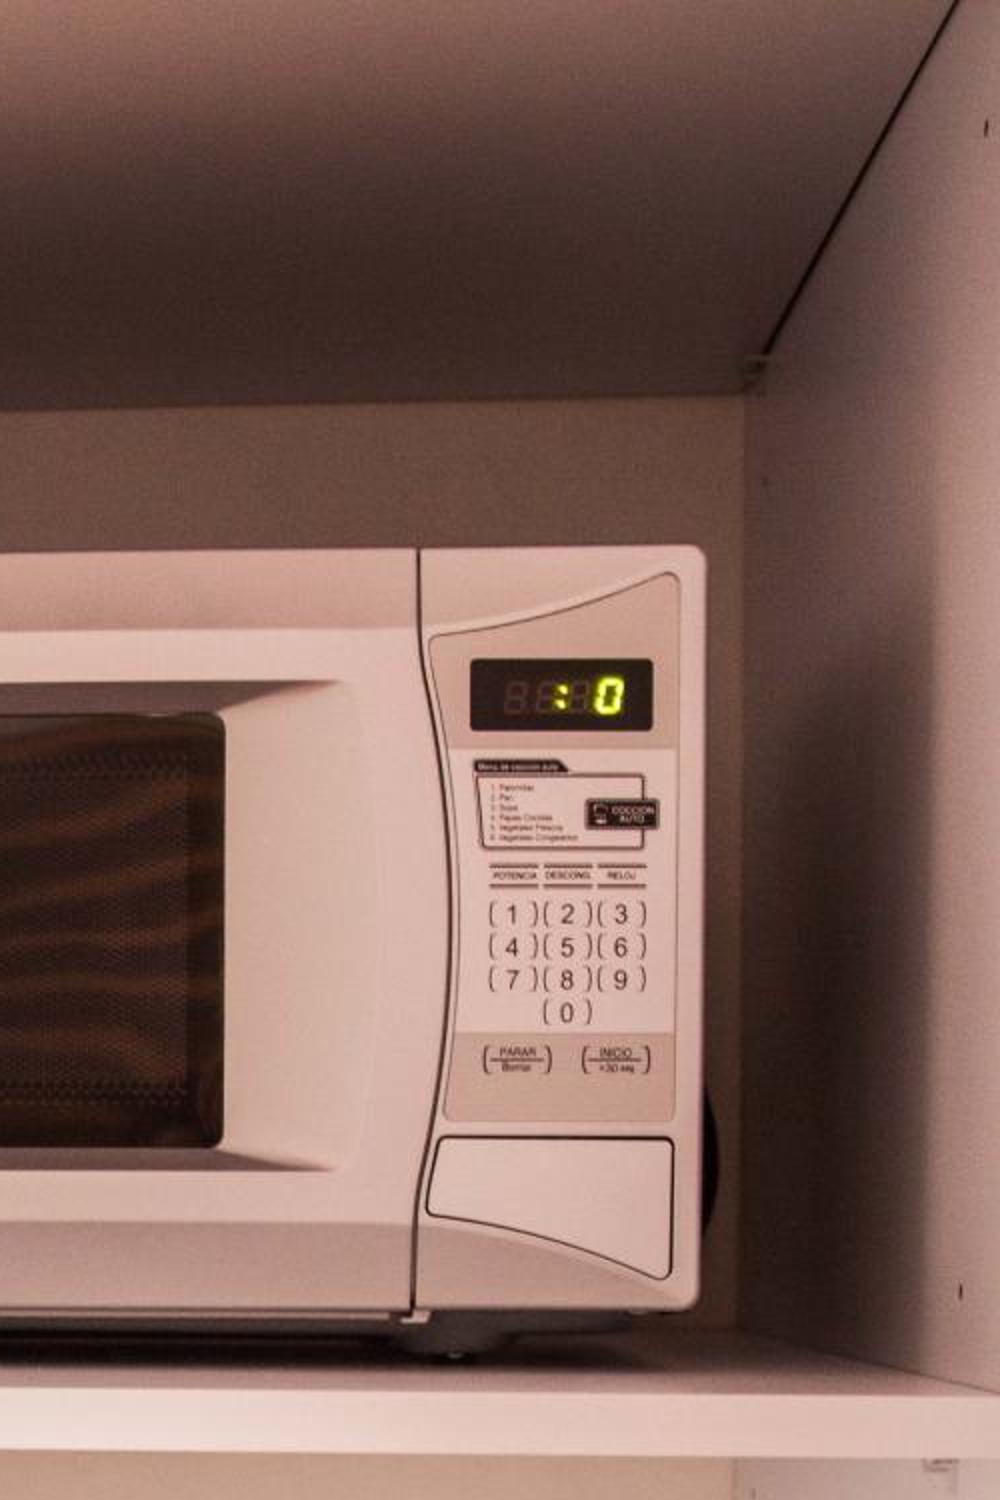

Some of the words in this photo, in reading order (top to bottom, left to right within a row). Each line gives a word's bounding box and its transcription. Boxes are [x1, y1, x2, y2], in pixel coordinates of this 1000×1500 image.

[618, 815, 645, 824] AUTO
[492, 871, 537, 880] POTENCIA
[607, 871, 636, 880] RELOJ
[499, 1047, 537, 1057] PARAR
[599, 1047, 632, 1057] INICIO
